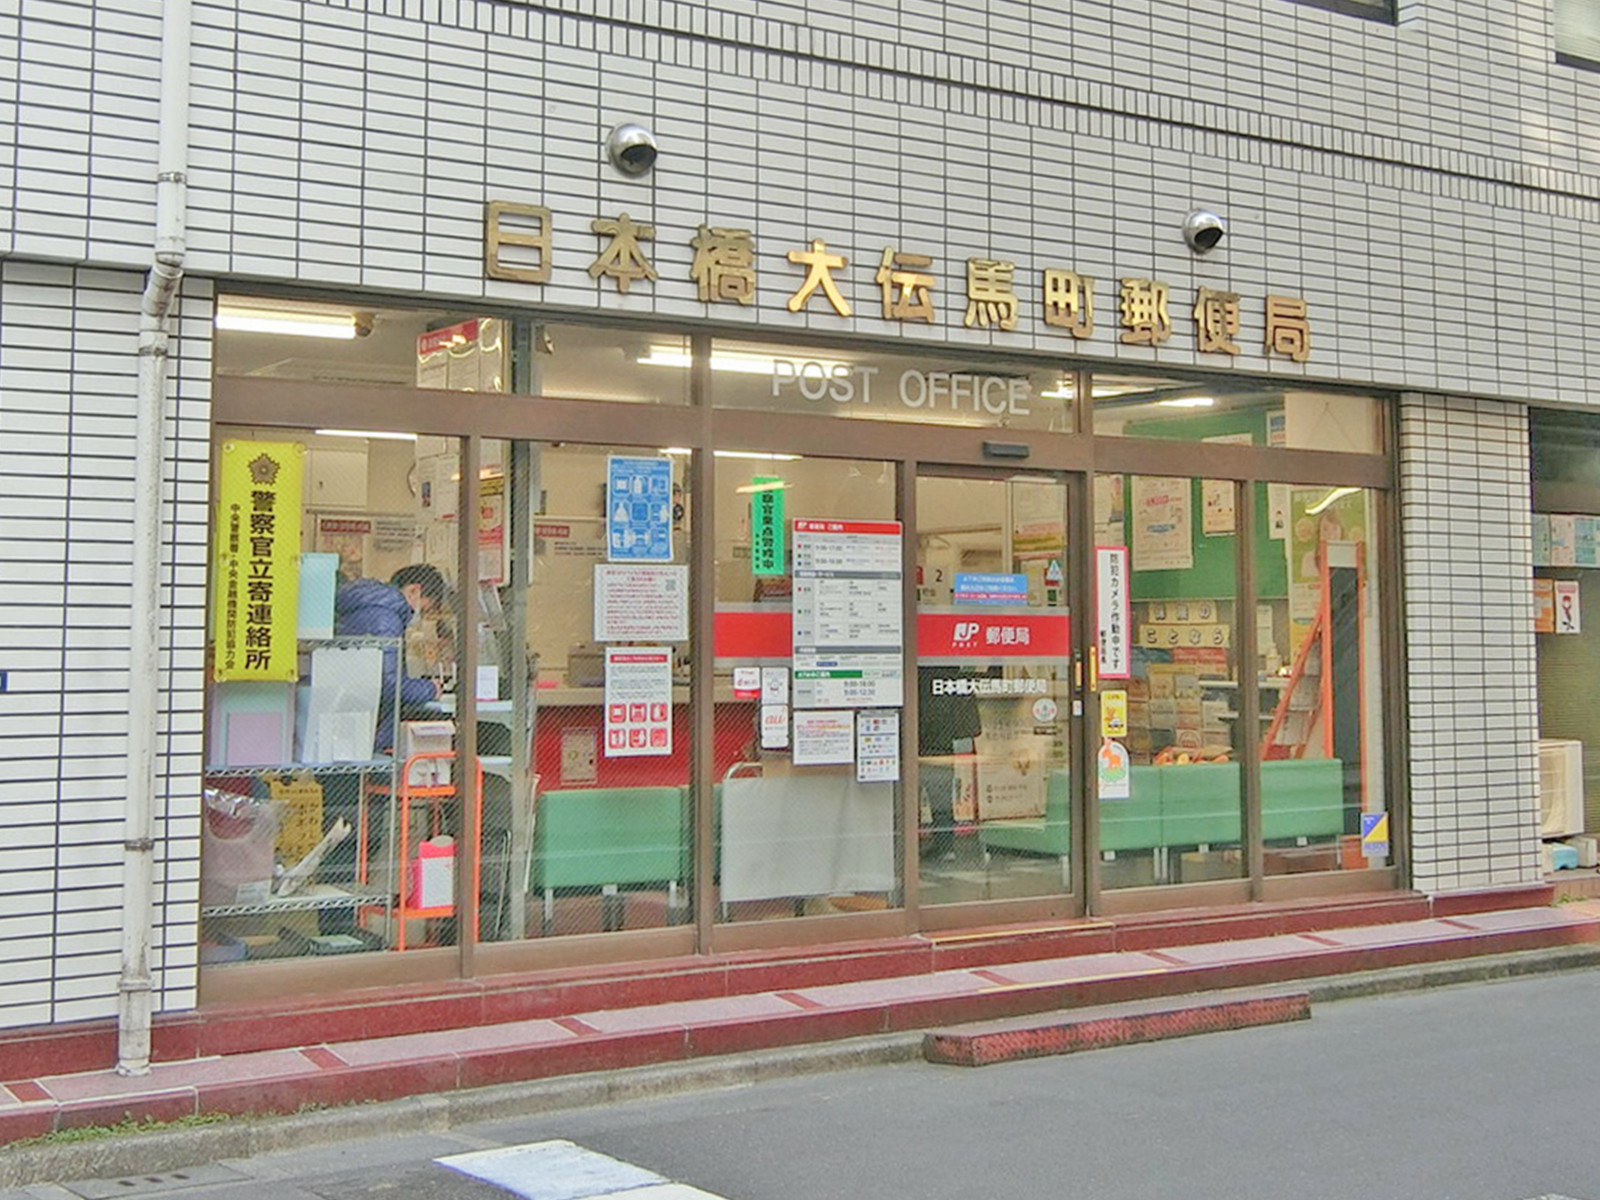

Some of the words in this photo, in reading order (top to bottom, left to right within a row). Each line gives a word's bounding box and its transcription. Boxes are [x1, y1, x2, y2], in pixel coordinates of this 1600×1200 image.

[484, 199, 1311, 362] 日本橋大伝馬町郵便局
[772, 359, 878, 403] POST
[900, 369, 1031, 415] OFFICE
[244, 490, 277, 671] 警察官立寄連絡所
[935, 569, 943, 582] 2
[986, 627, 1030, 645] 郵便局
[1146, 627, 1224, 644] ことなら
[932, 679, 1048, 696] 日本橋大伝馬町郵便局
